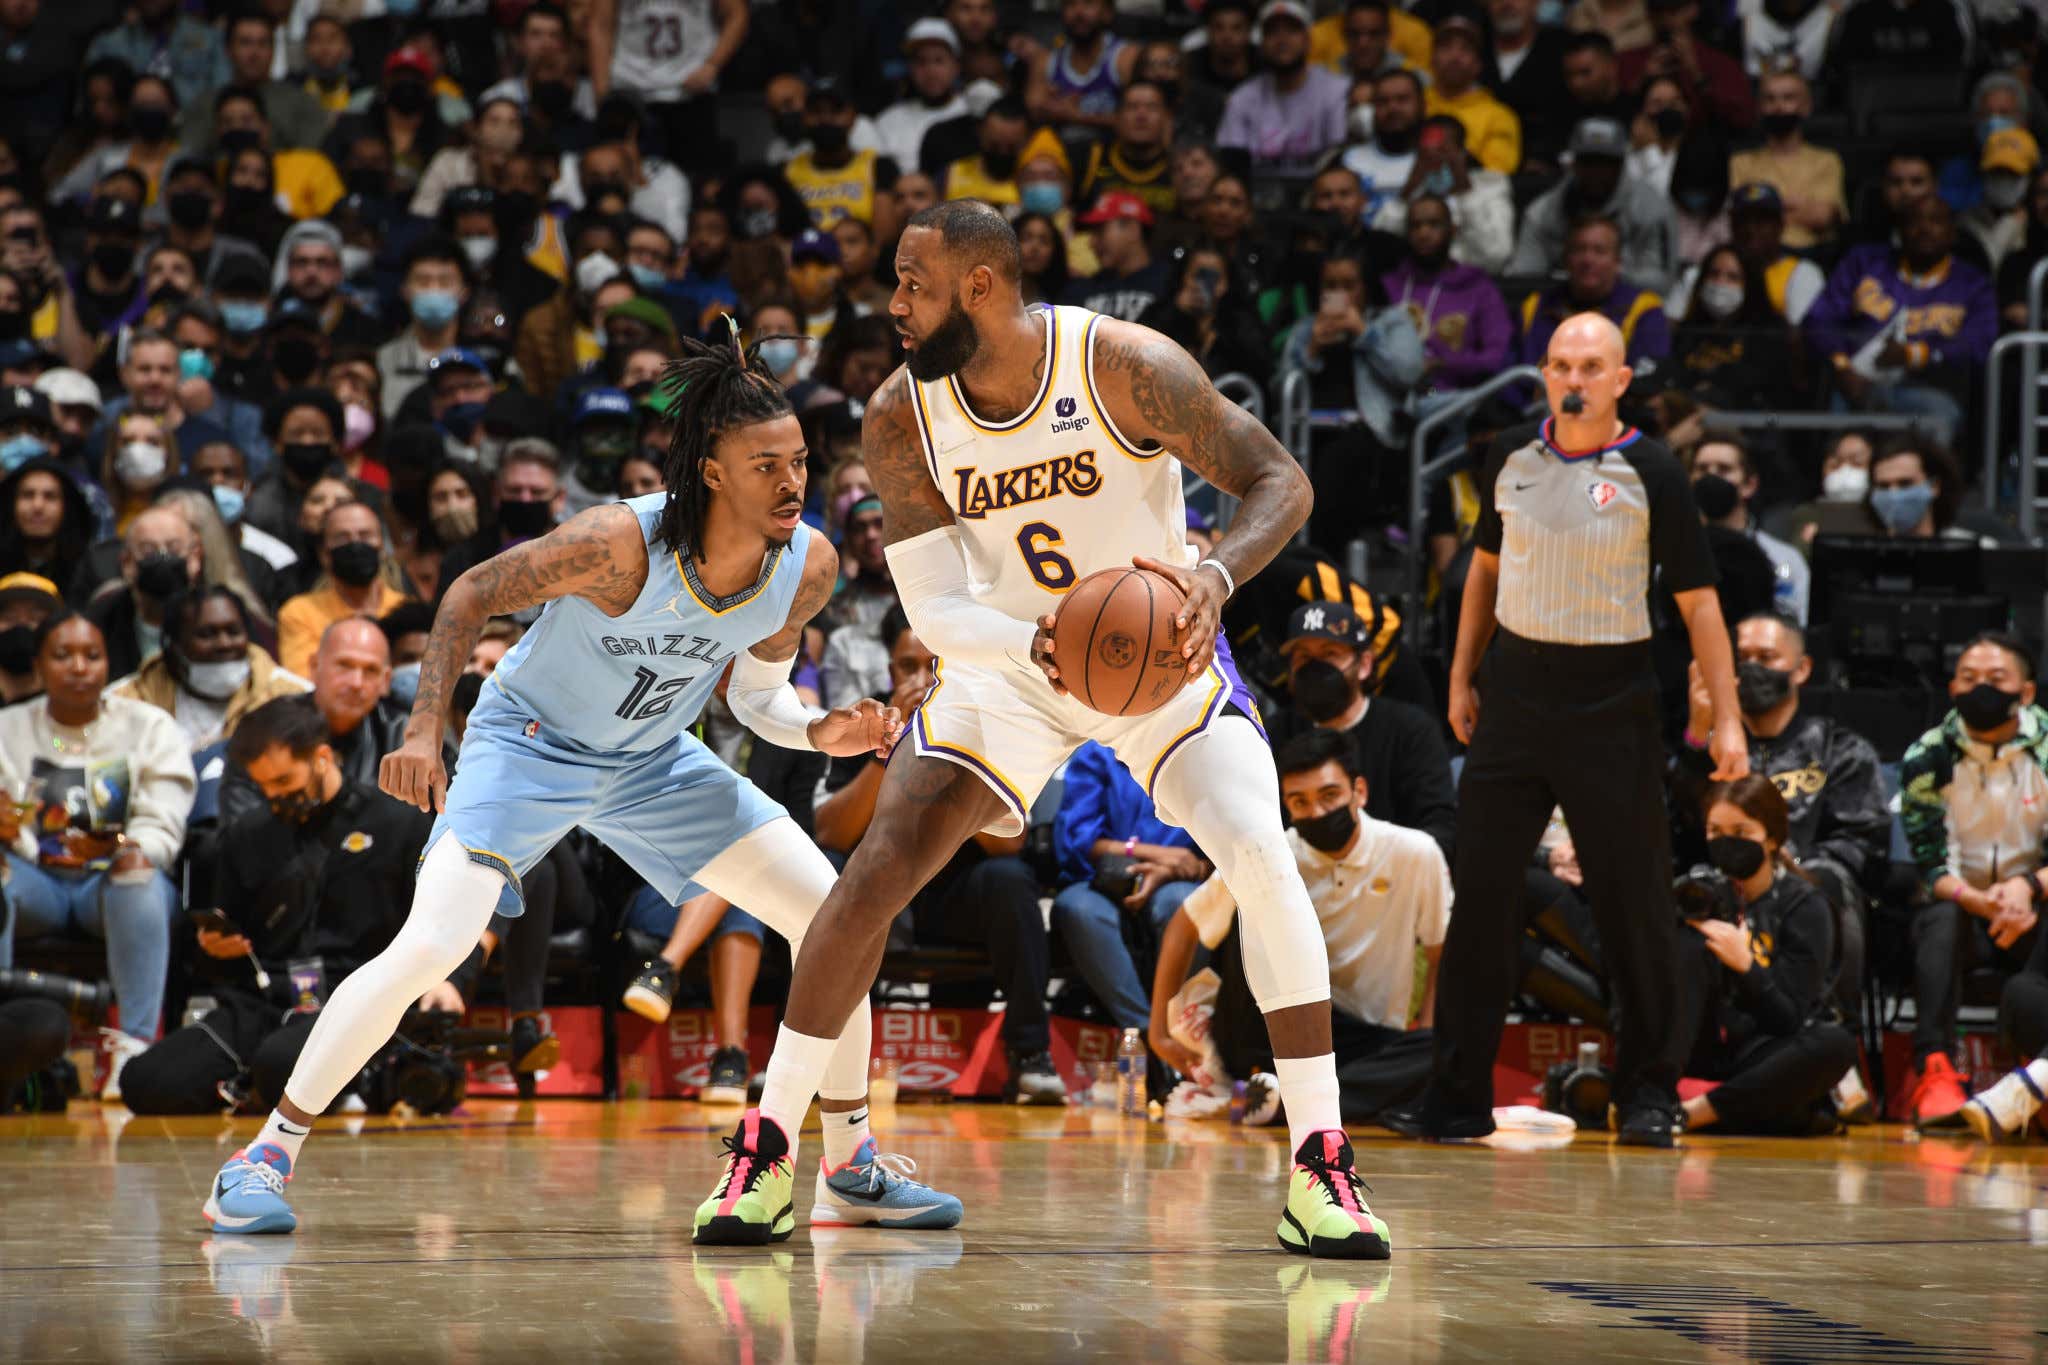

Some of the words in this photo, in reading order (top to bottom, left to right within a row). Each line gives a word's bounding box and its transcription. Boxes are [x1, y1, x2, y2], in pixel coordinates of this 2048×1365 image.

[645, 14, 683, 58] 23
[1051, 415, 1090, 434] bibigo
[954, 448, 1104, 521] LAKERS
[1014, 520, 1081, 596] 6
[614, 665, 695, 721] 12
[882, 1013, 962, 1042] BIO
[882, 1043, 961, 1059] STEEL
